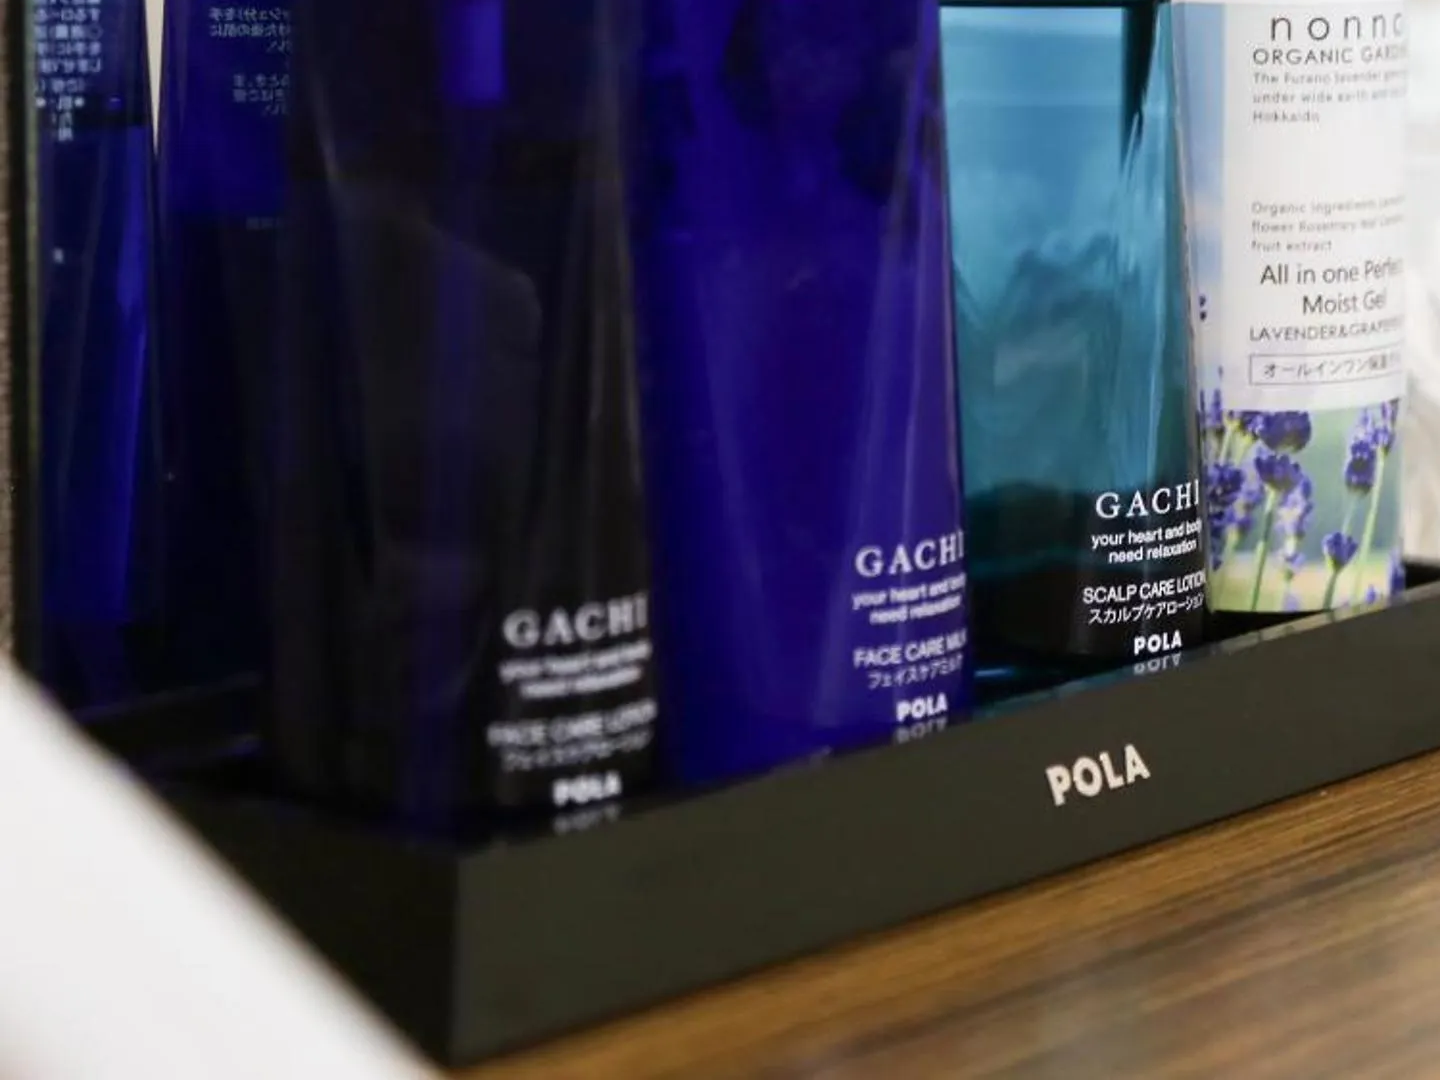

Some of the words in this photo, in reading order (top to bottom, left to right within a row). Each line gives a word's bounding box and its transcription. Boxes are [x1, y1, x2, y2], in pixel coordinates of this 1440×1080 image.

[1252, 47, 1353, 65] ORGANIC
[1251, 201, 1307, 217] Organic
[1260, 263, 1290, 286] All
[1296, 263, 1316, 285] in
[1322, 266, 1360, 285] one
[1302, 293, 1359, 316] Moist
[1095, 479, 1200, 519] GACHI
[1091, 531, 1125, 550] your
[1128, 528, 1163, 545] heart
[854, 528, 965, 578] GACHI
[1108, 547, 1144, 565] need
[1082, 584, 1138, 605] SCALP
[1139, 578, 1176, 601] CARE
[853, 645, 902, 668] FACE
[904, 634, 945, 662] CARE
[1133, 629, 1183, 656] POLA
[896, 692, 949, 722] POLA
[1045, 743, 1152, 807] POLA
